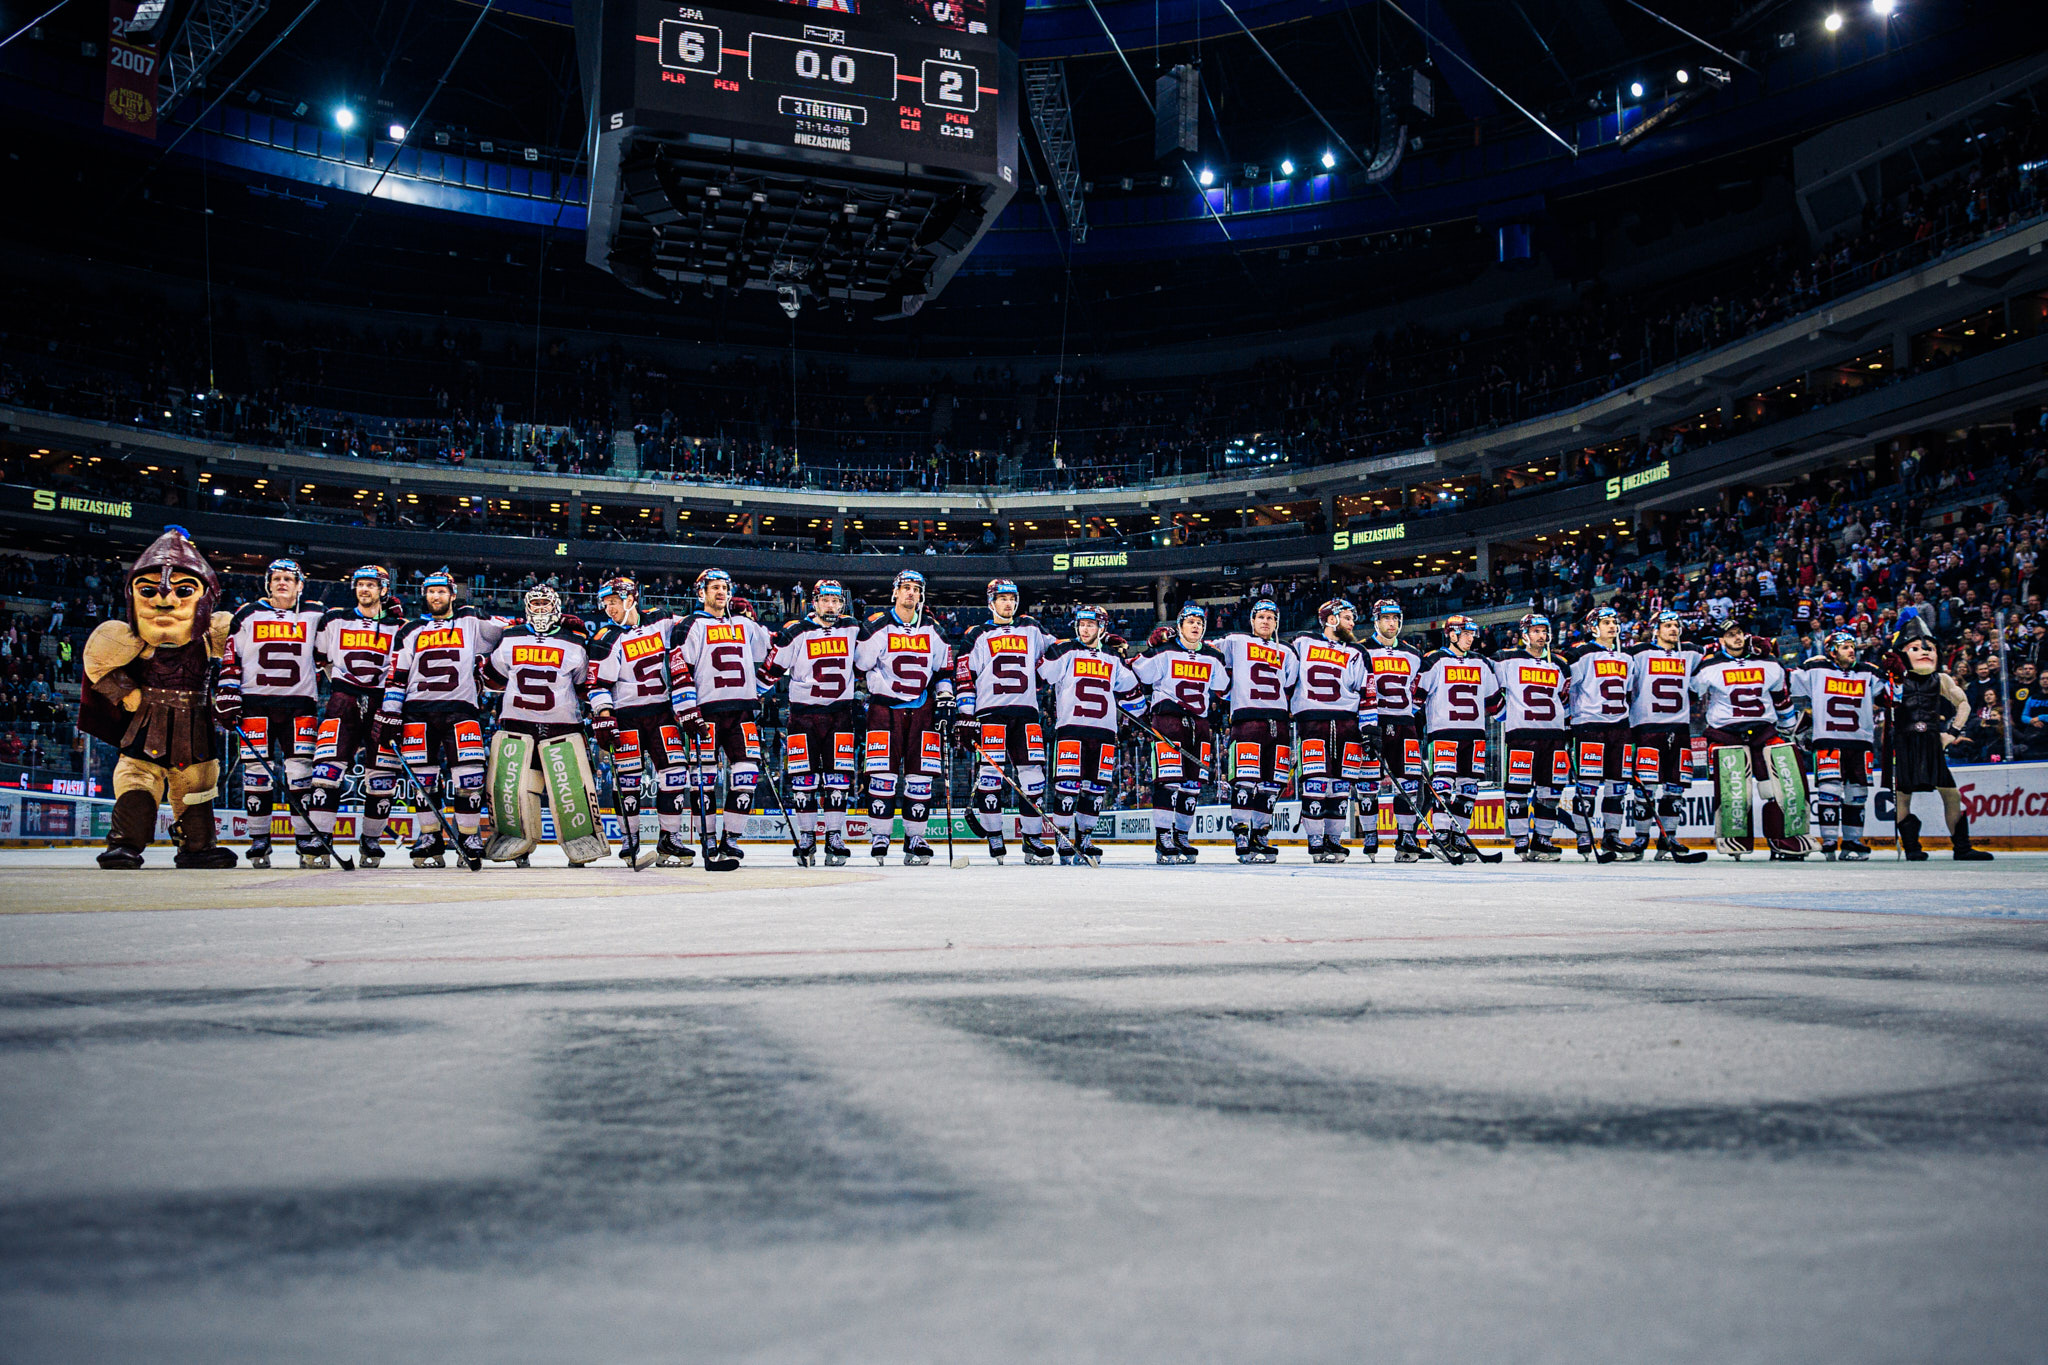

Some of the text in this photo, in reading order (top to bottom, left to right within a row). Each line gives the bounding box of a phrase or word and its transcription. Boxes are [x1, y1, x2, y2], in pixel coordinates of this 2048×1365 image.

[679, 7, 704, 21] SPA
[678, 31, 705, 63] 6
[939, 48, 961, 61] KLA
[111, 46, 155, 76] 2007
[796, 49, 856, 84] 0.0
[662, 71, 686, 84] PLR
[939, 70, 963, 102] 2
[899, 106, 921, 118] PLR
[610, 112, 624, 130] S
[940, 124, 974, 139] 0:39
[794, 133, 851, 151] #NEZASTAVÍŠ
[1622, 461, 1670, 492] #NEZASTAVÍŠ
[60, 496, 133, 519] #NEZASTAVÍŠ
[1352, 523, 1405, 545] #NEZASTAVÍŠ
[555, 543, 568, 556] JE
[1073, 552, 1128, 568] #NEZASTAVÍŠ
[257, 625, 302, 638] BILLA
[418, 631, 461, 648] BILLA
[708, 627, 743, 640] BILLA
[343, 633, 386, 650] BILLA
[626, 637, 663, 657] BILLA
[810, 641, 846, 655] BILLA
[891, 637, 927, 650] BILLA
[992, 638, 1026, 653] BILLA
[516, 649, 559, 664] BILLA
[1251, 647, 1281, 665] BILLA
[1310, 648, 1344, 664] BILLA
[256, 643, 302, 687] S
[343, 651, 384, 687] S
[417, 650, 460, 692] S
[711, 646, 746, 688] S
[1175, 664, 1207, 679] BILLA
[1375, 660, 1409, 672] BILLA
[1598, 663, 1626, 675] BILLA
[1652, 661, 1684, 672] BILLA
[633, 653, 667, 697] S
[810, 658, 846, 698] S
[891, 655, 928, 695] S
[992, 655, 1028, 695] S
[1250, 662, 1281, 701] S
[1307, 665, 1342, 702] S
[1448, 669, 1480, 681] BILLA
[1522, 670, 1556, 684] BILLA
[1726, 671, 1762, 682] BILLA
[513, 668, 557, 711] S
[1377, 674, 1410, 709] S
[1651, 678, 1683, 713] S
[1828, 680, 1863, 694] BILLA
[1073, 677, 1111, 719] S
[1175, 681, 1206, 718] S
[1448, 684, 1479, 721] S
[1523, 684, 1556, 721] S
[1600, 679, 1627, 714] S
[1729, 687, 1765, 717] S
[1825, 696, 1862, 732] S
[460, 733, 480, 741] kika
[984, 735, 1003, 744] kika
[868, 743, 887, 751] kika
[1060, 751, 1078, 759] kika
[1160, 751, 1179, 759] kika
[1305, 749, 1322, 757] kika
[1103, 756, 1114, 764] kik
[464, 776, 483, 788] PR
[669, 774, 686, 784] PR
[590, 792, 602, 827] CCM
